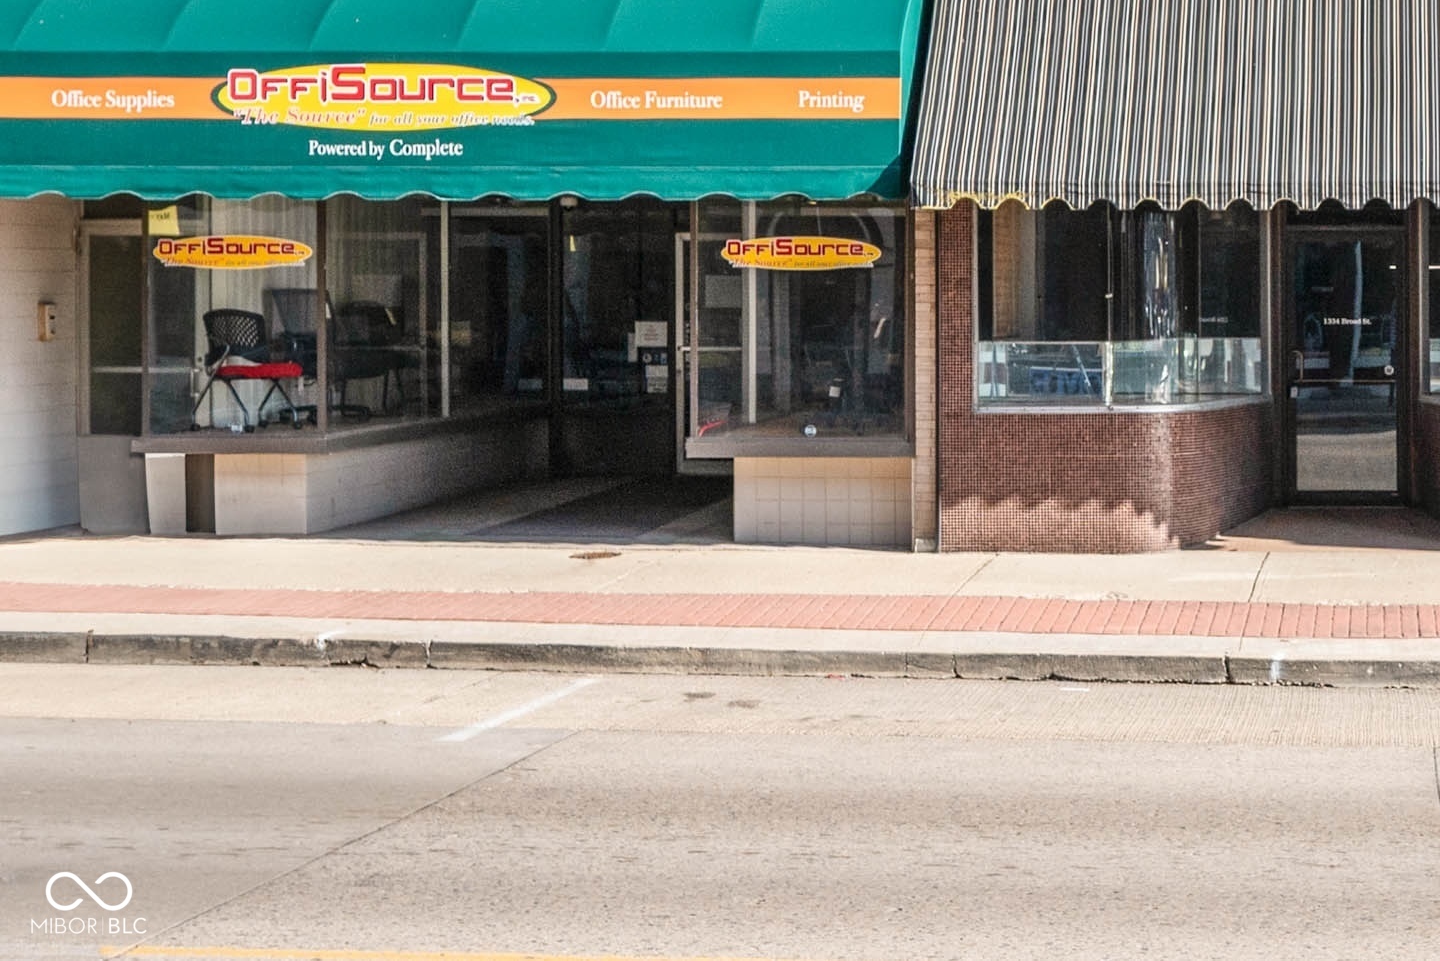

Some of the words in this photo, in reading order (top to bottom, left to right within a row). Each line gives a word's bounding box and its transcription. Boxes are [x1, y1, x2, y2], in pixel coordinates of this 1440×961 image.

[51, 89, 102, 108] Office
[105, 89, 175, 113] Supplies
[590, 90, 641, 110] Office
[645, 91, 723, 110] Furniture
[799, 90, 866, 113] Printing
[394, 114, 413, 125] all
[308, 140, 367, 156] Powered
[369, 140, 385, 160] by
[389, 139, 464, 161] Complete
